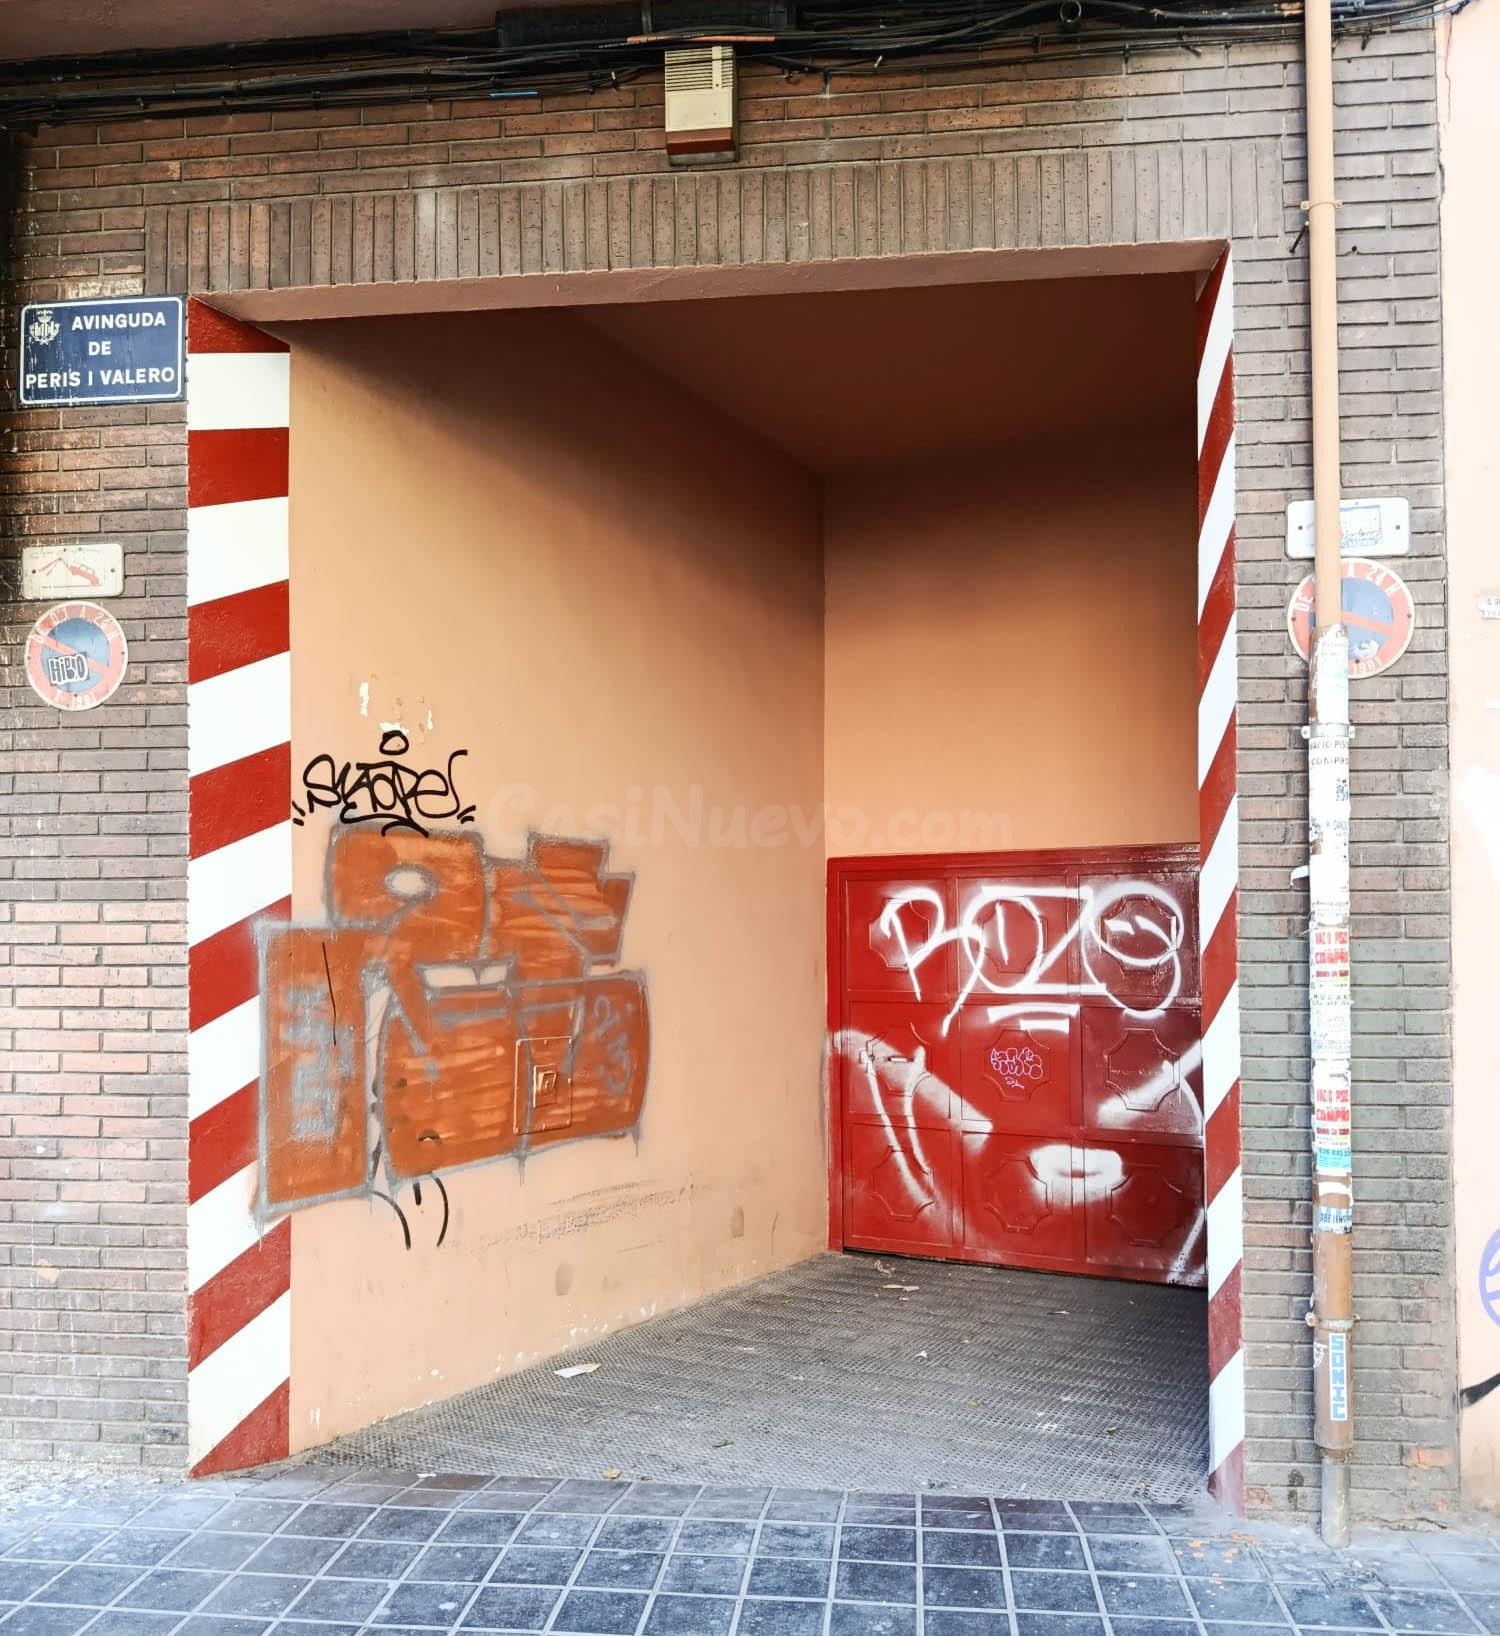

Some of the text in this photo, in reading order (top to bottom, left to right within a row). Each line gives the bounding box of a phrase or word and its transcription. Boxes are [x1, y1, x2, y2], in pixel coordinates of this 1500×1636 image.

[71, 312, 166, 331] AVINGUDA
[88, 341, 112, 356] DE
[25, 367, 175, 389] PERIS I VALERO
[1331, 1335, 1346, 1420] SONIC
